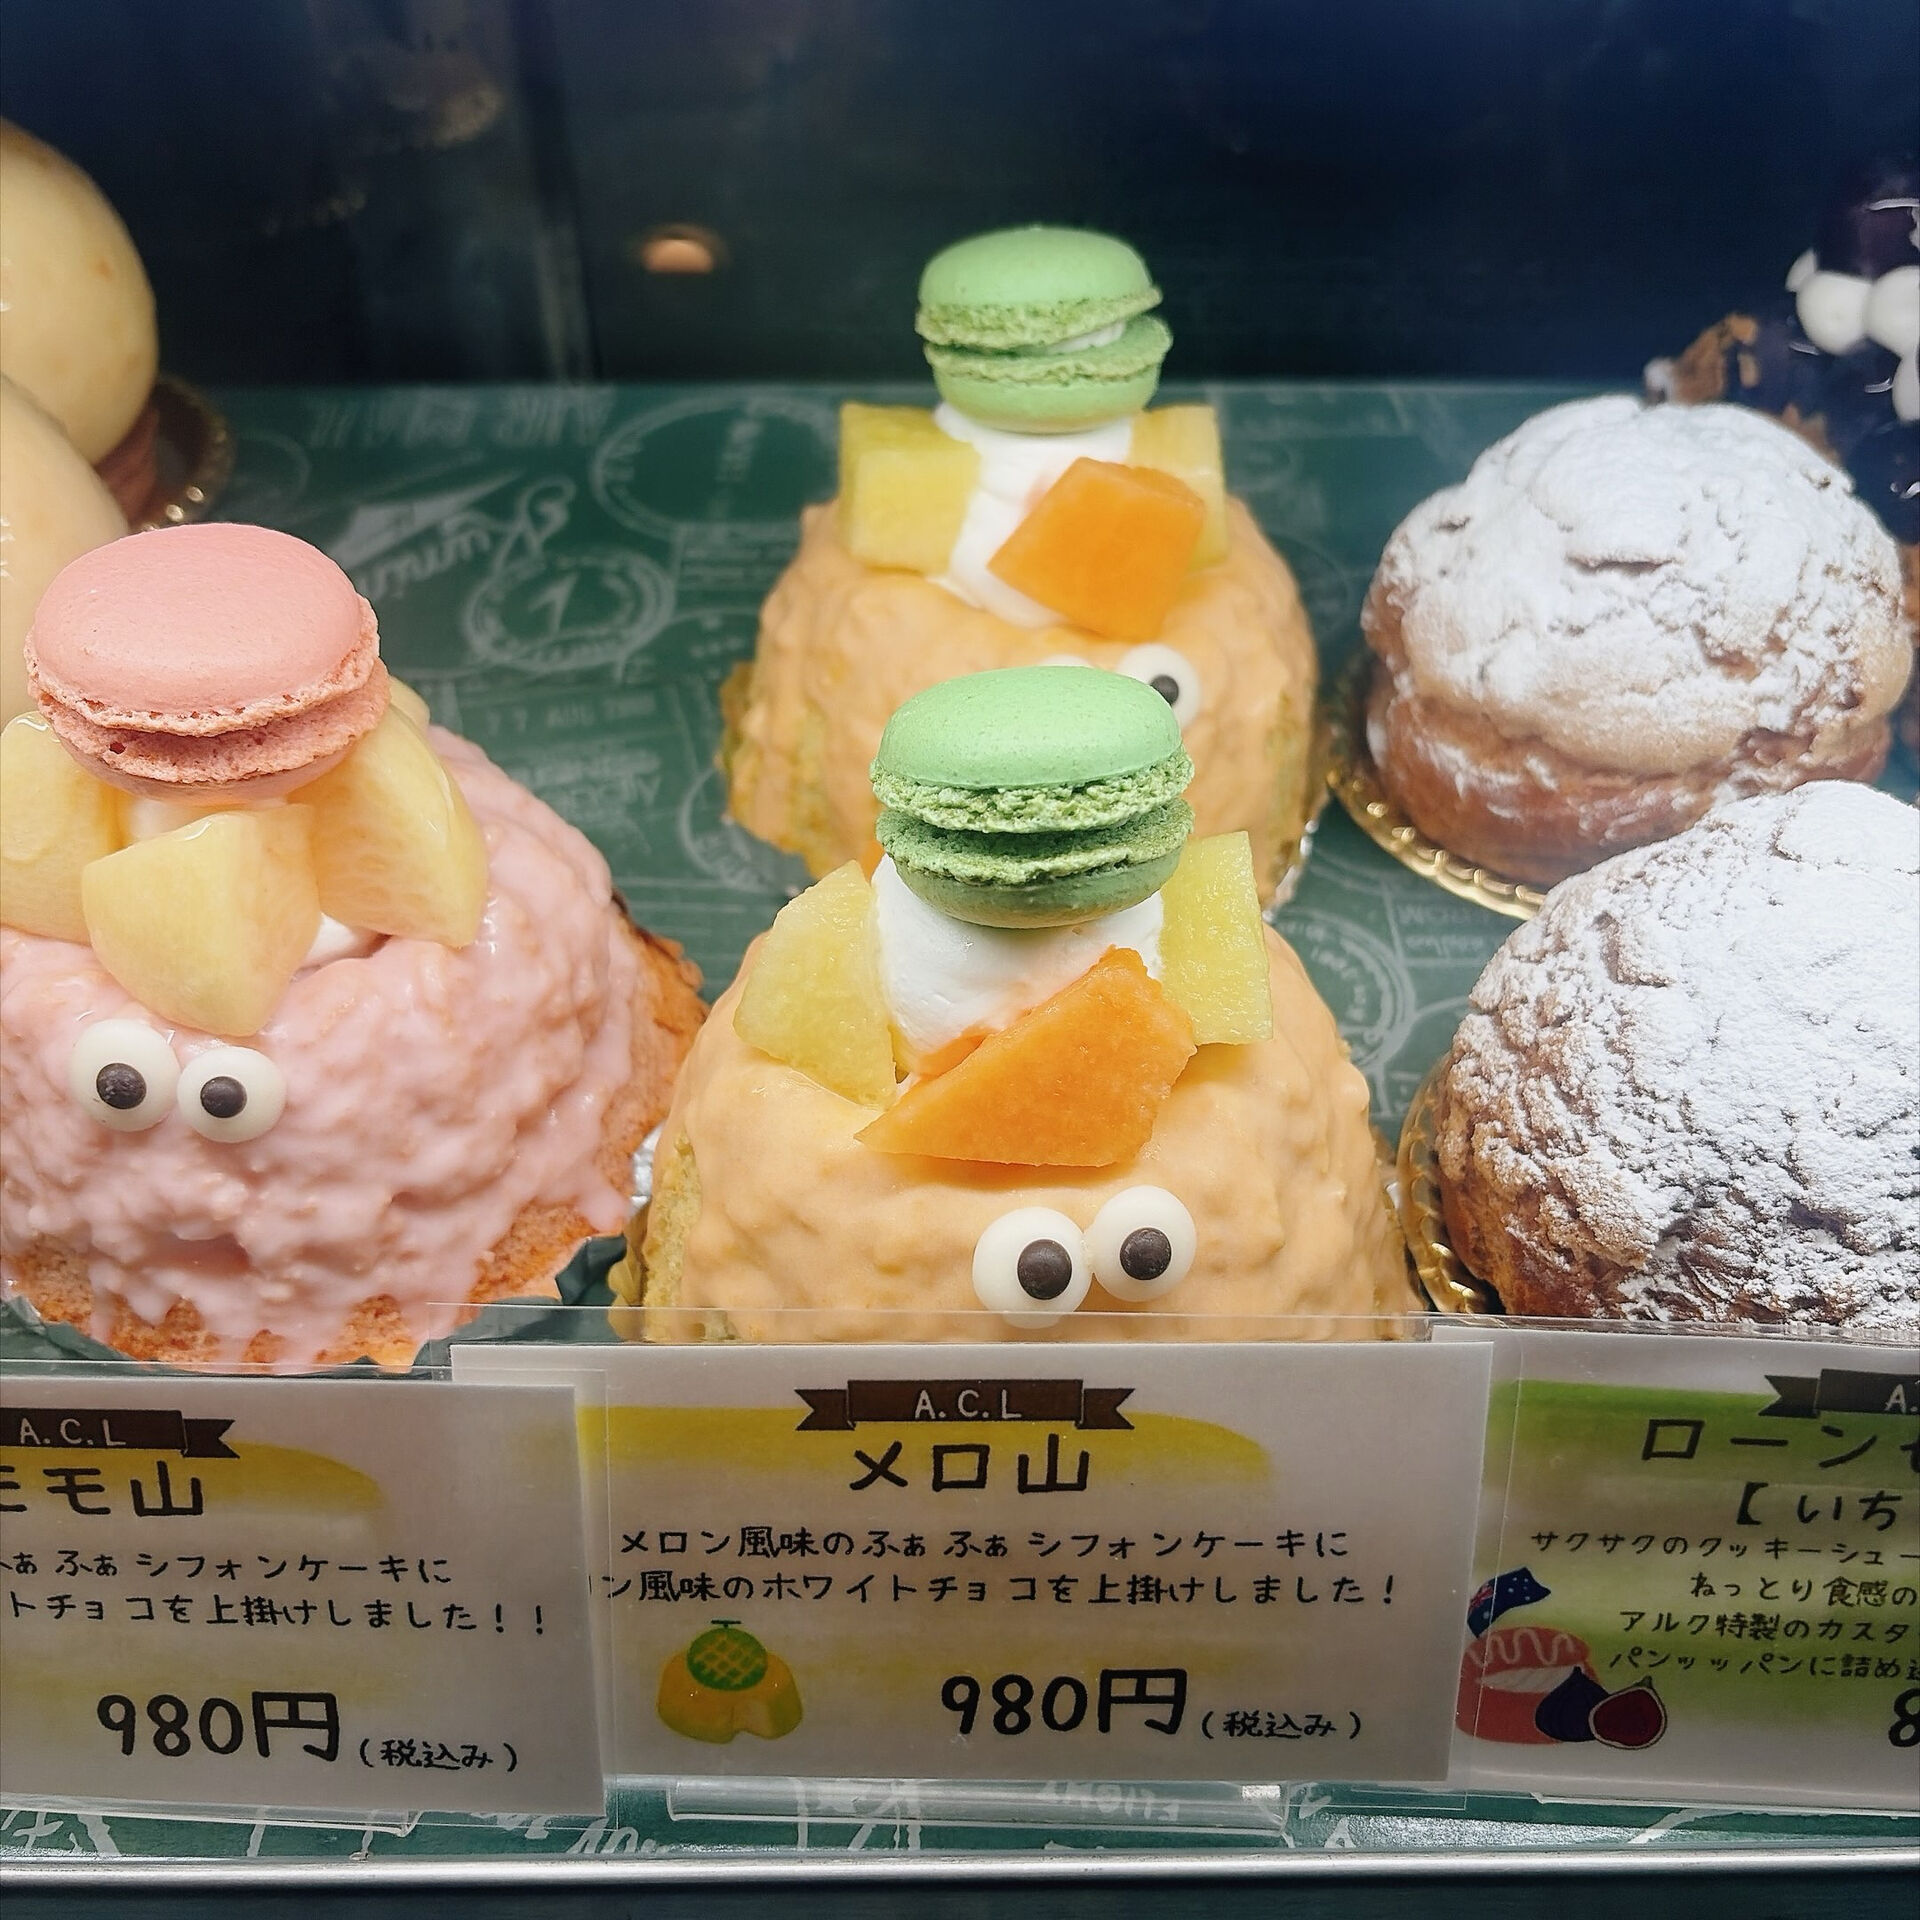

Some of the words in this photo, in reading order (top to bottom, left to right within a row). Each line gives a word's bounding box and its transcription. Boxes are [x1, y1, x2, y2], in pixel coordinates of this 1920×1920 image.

[915, 1389, 1023, 1420] A.C.L
[1884, 1379, 1920, 1413] A.
[19, 1417, 127, 1448] A.C.L
[849, 1433, 1091, 1495] メロ山
[0, 1550, 452, 1584] ぁふぁシフォンケーキに
[588, 1570, 1394, 1606] ン風味のホワイトチョコを上掛けしました!
[941, 1668, 1188, 1736] 980円
[97, 1691, 341, 1762] 980円
